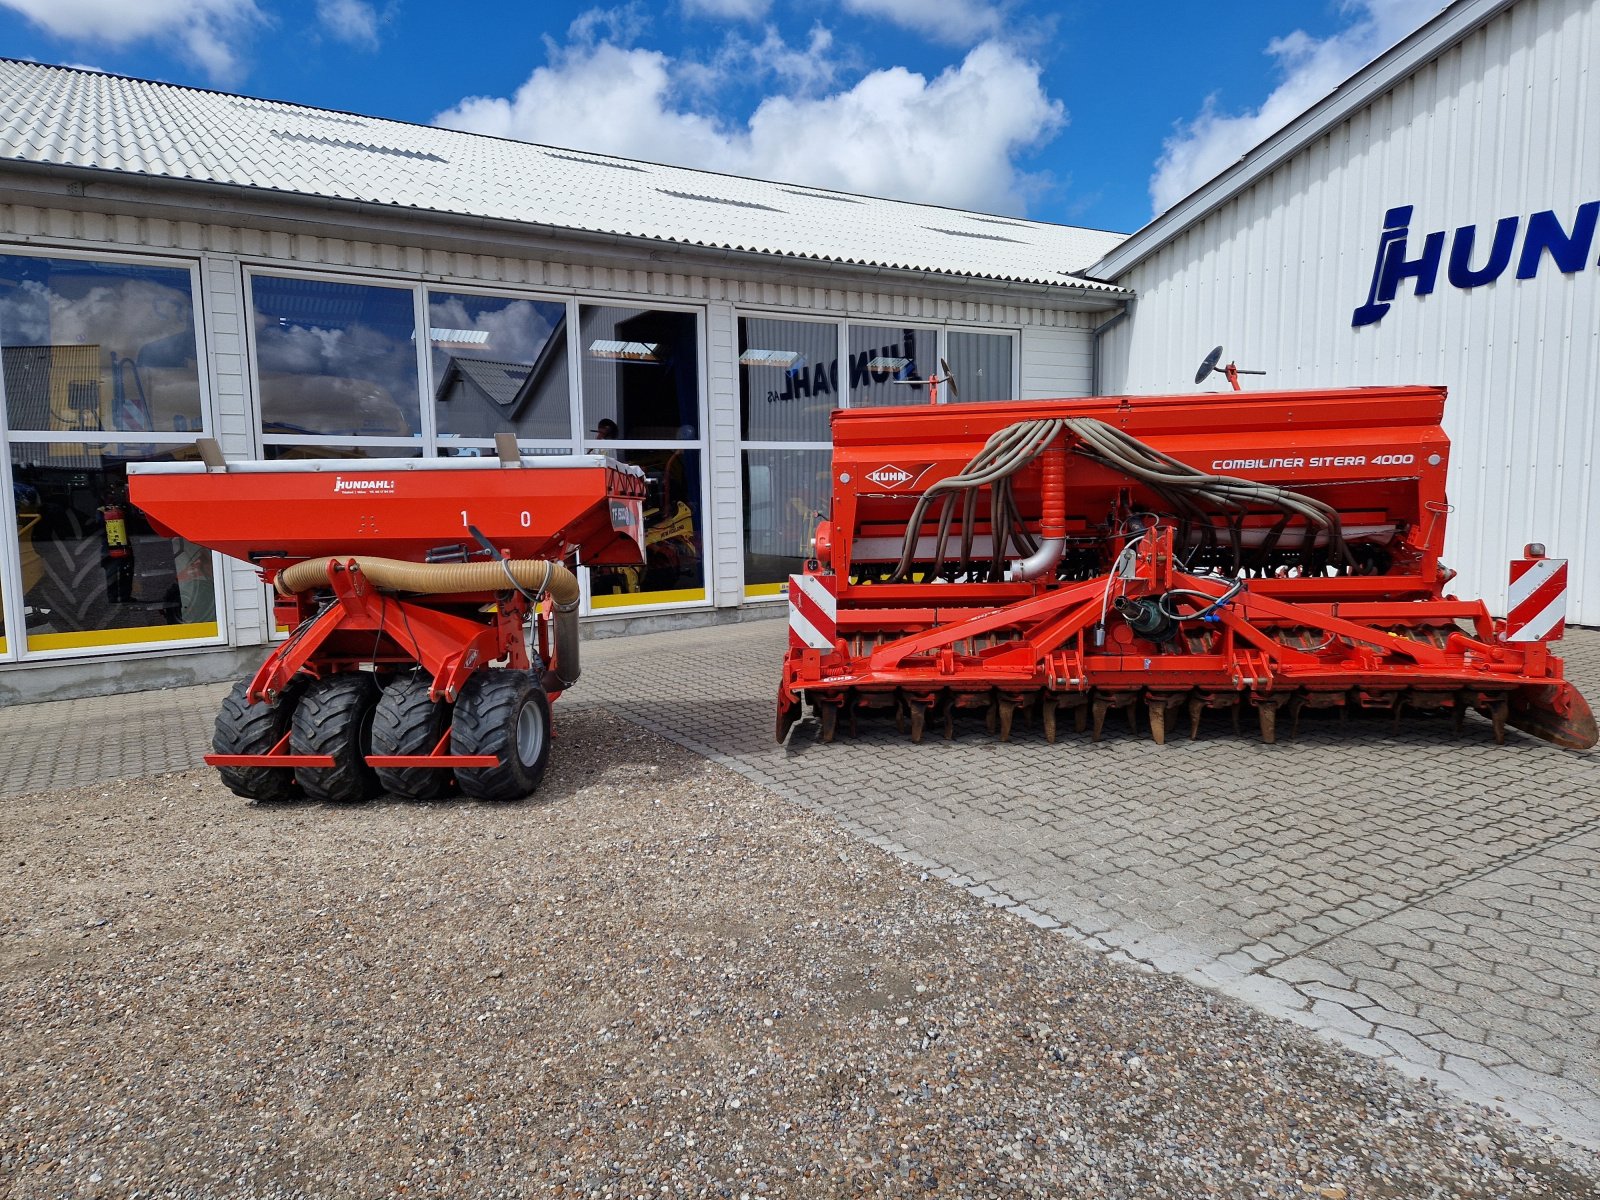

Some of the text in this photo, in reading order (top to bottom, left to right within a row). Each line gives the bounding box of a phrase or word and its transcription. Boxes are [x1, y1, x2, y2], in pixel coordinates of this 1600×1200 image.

[1211, 454, 1415, 470] COMBILINER SITERA 4000
[872, 472, 906, 481] KUHN
[460, 510, 531, 527] 1 0
